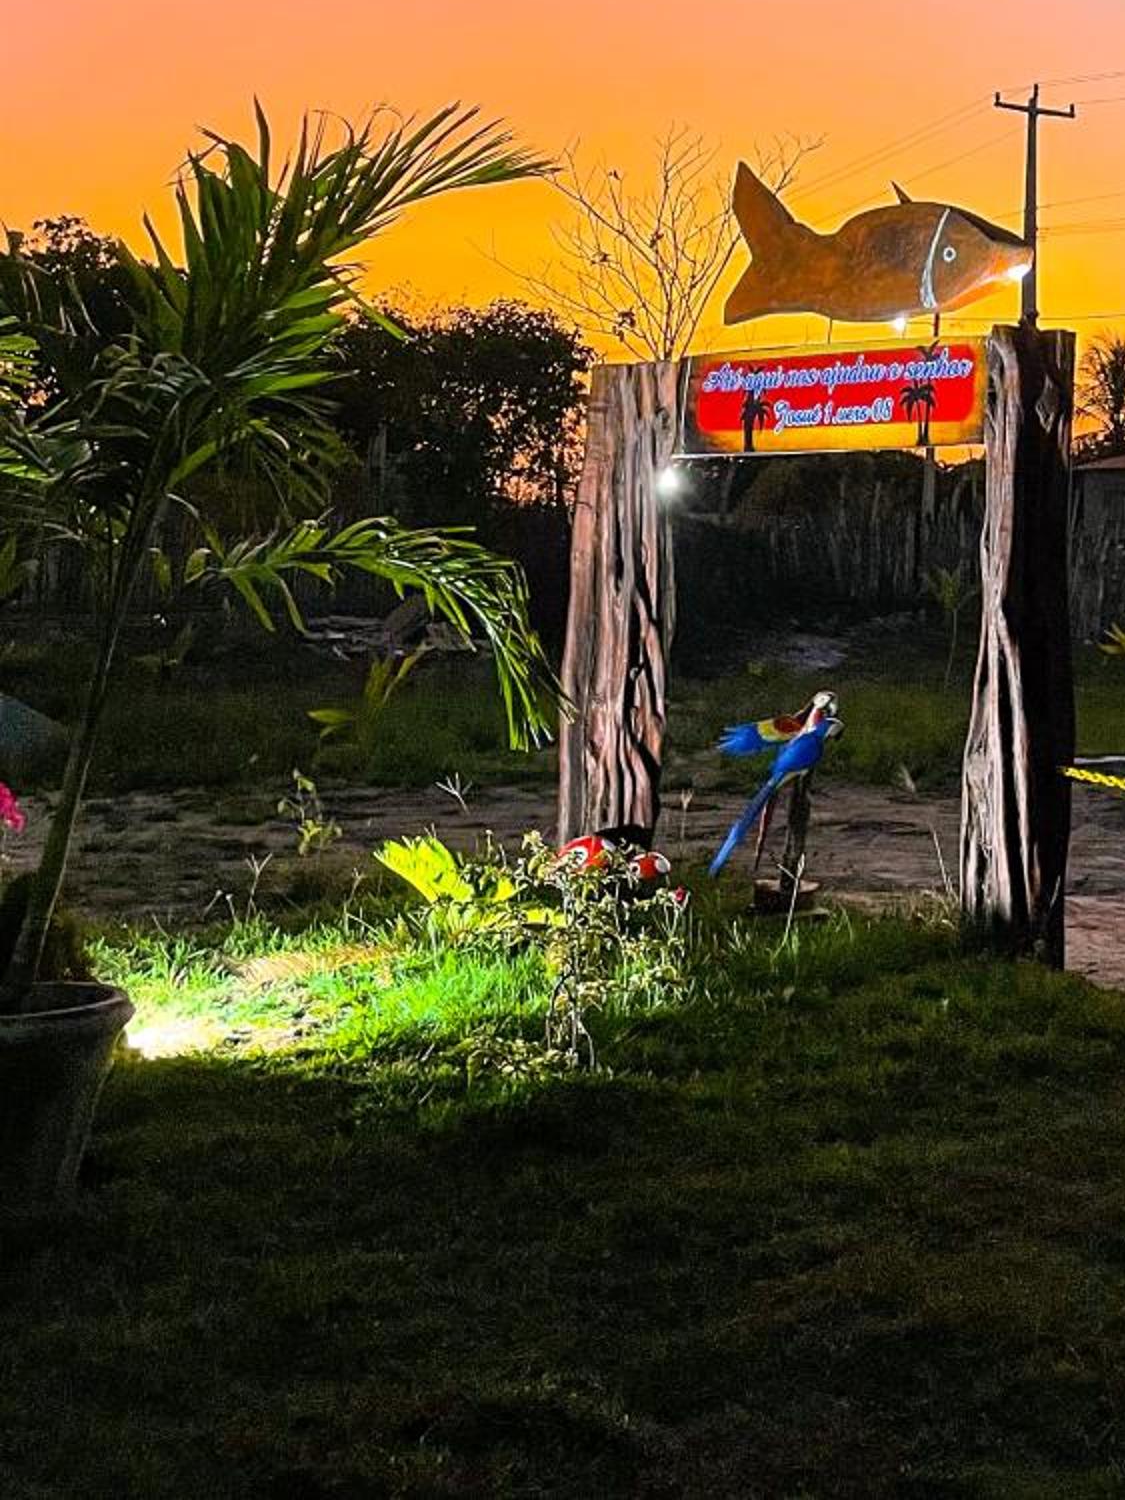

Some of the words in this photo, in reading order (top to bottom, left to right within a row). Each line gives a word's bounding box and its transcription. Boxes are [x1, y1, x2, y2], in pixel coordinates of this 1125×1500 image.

[783, 368, 818, 388] nos
[821, 354, 886, 395] ajudou
[904, 347, 972, 379] senhor
[774, 400, 822, 434] Josué
